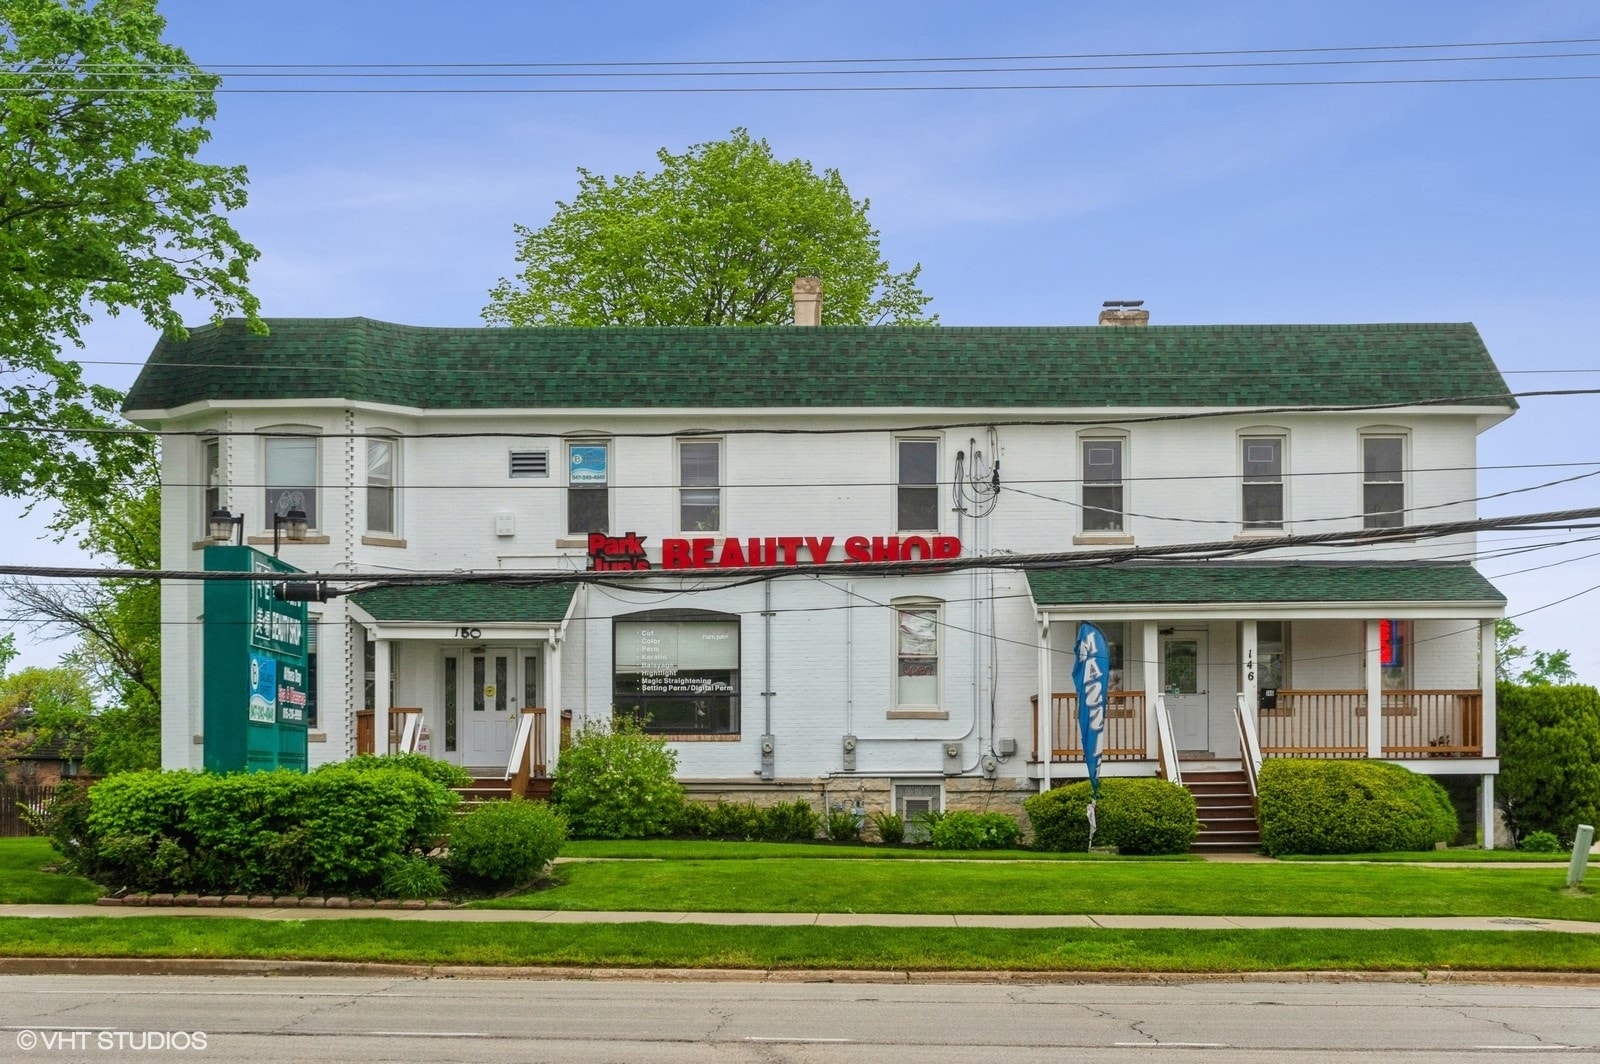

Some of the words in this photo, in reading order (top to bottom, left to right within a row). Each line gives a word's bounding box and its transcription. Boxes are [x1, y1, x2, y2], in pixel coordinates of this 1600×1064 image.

[588, 532, 647, 557] Park
[662, 536, 835, 569] BEAUTY
[844, 535, 961, 568] SHOP
[454, 627, 482, 639] 150
[1246, 649, 1254, 681] 146
